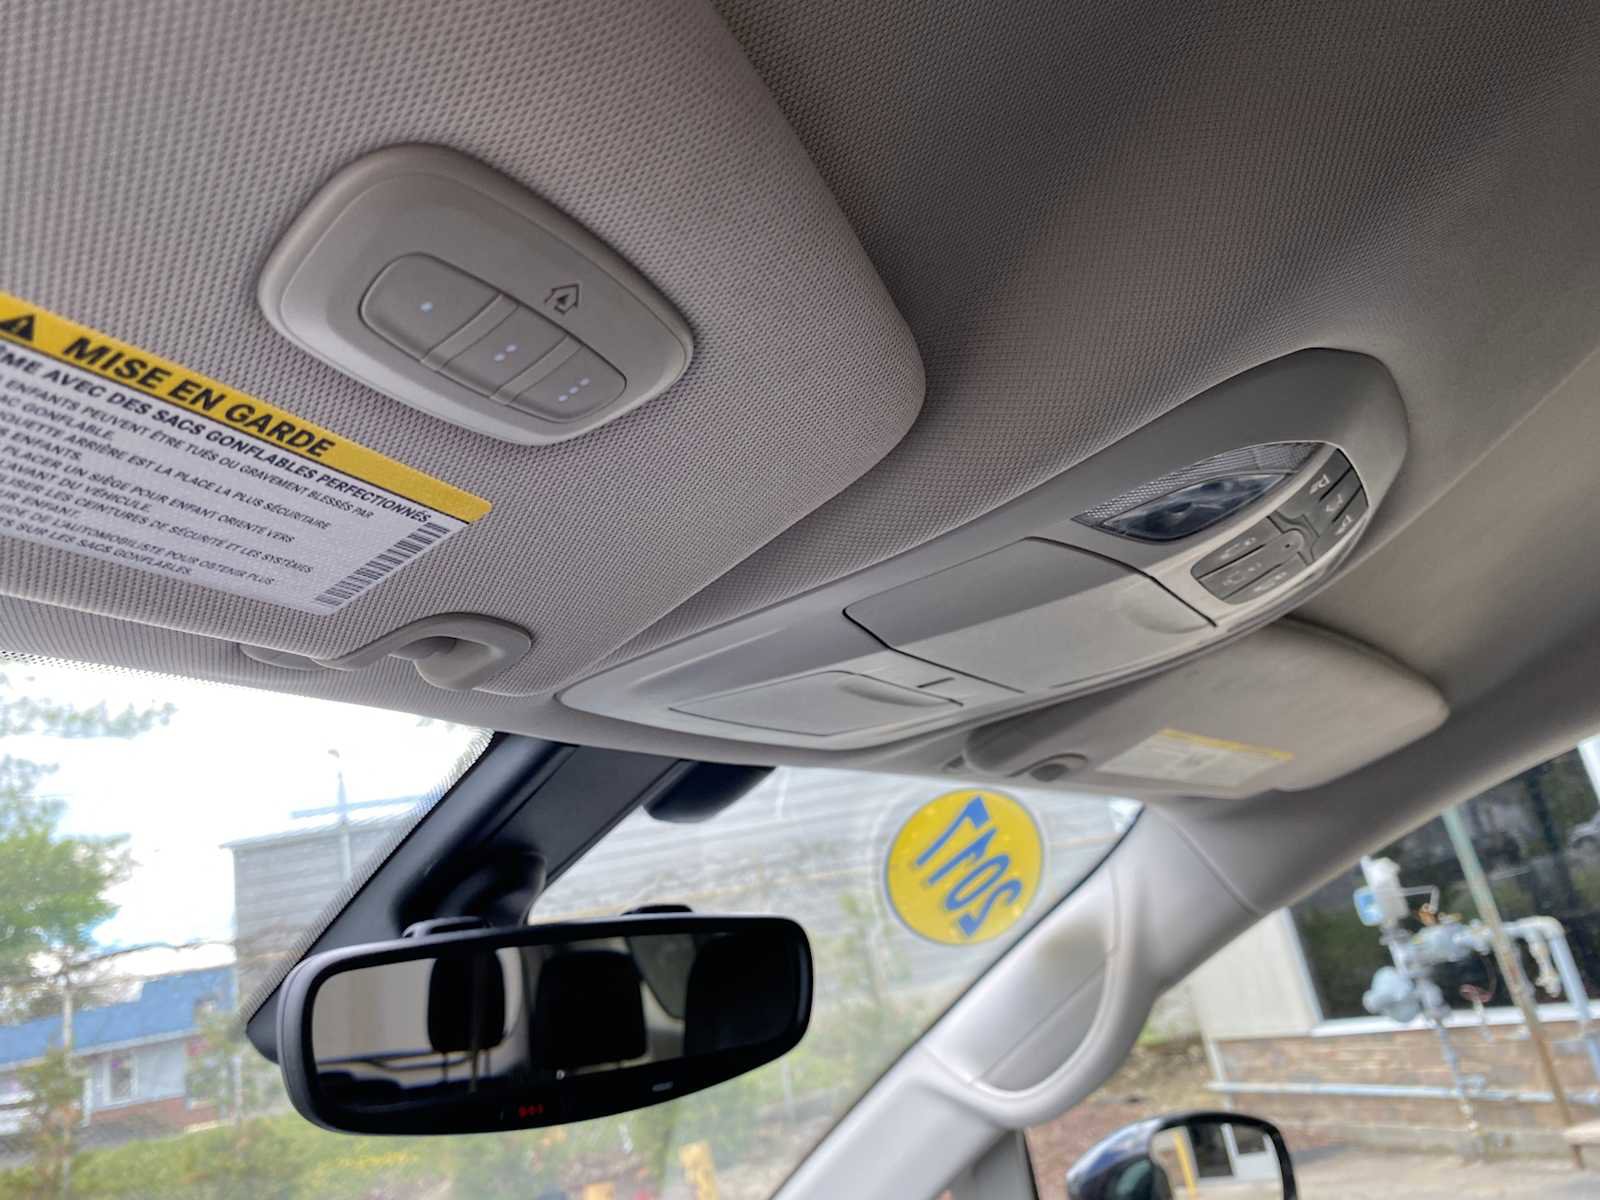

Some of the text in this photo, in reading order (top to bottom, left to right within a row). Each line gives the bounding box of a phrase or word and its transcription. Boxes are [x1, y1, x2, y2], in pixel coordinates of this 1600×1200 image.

[0, 344, 431, 523] ME AVEC DES SACS GONFLABLES PERFECTIONNÉS
[62, 337, 335, 457] MISE EN GARDE
[5, 380, 80, 411] ENFANTS
[81, 406, 151, 436] PEUVENT
[218, 457, 241, 469] OU
[239, 465, 309, 495] GRAVEMENT
[352, 507, 374, 519] PAR
[58, 478, 84, 491] DU
[63, 434, 128, 459] ARRIÈRE
[127, 456, 156, 469] EST
[154, 465, 173, 476] LA
[173, 471, 216, 490] PLACE
[214, 485, 232, 497] LA
[231, 491, 264, 507] PLUS
[2, 445, 62, 469] PLACER
[63, 465, 88, 477] UN
[130, 485, 168, 504] POUR
[168, 498, 219, 519] ENFANT
[265, 529, 296, 543] VERS
[44, 487, 74, 502] LES
[74, 498, 149, 525] CEINTURES
[149, 520, 171, 530] DE
[240, 547, 262, 559] LES
[16, 522, 48, 536] SUR
[76, 539, 113, 553] SACS
